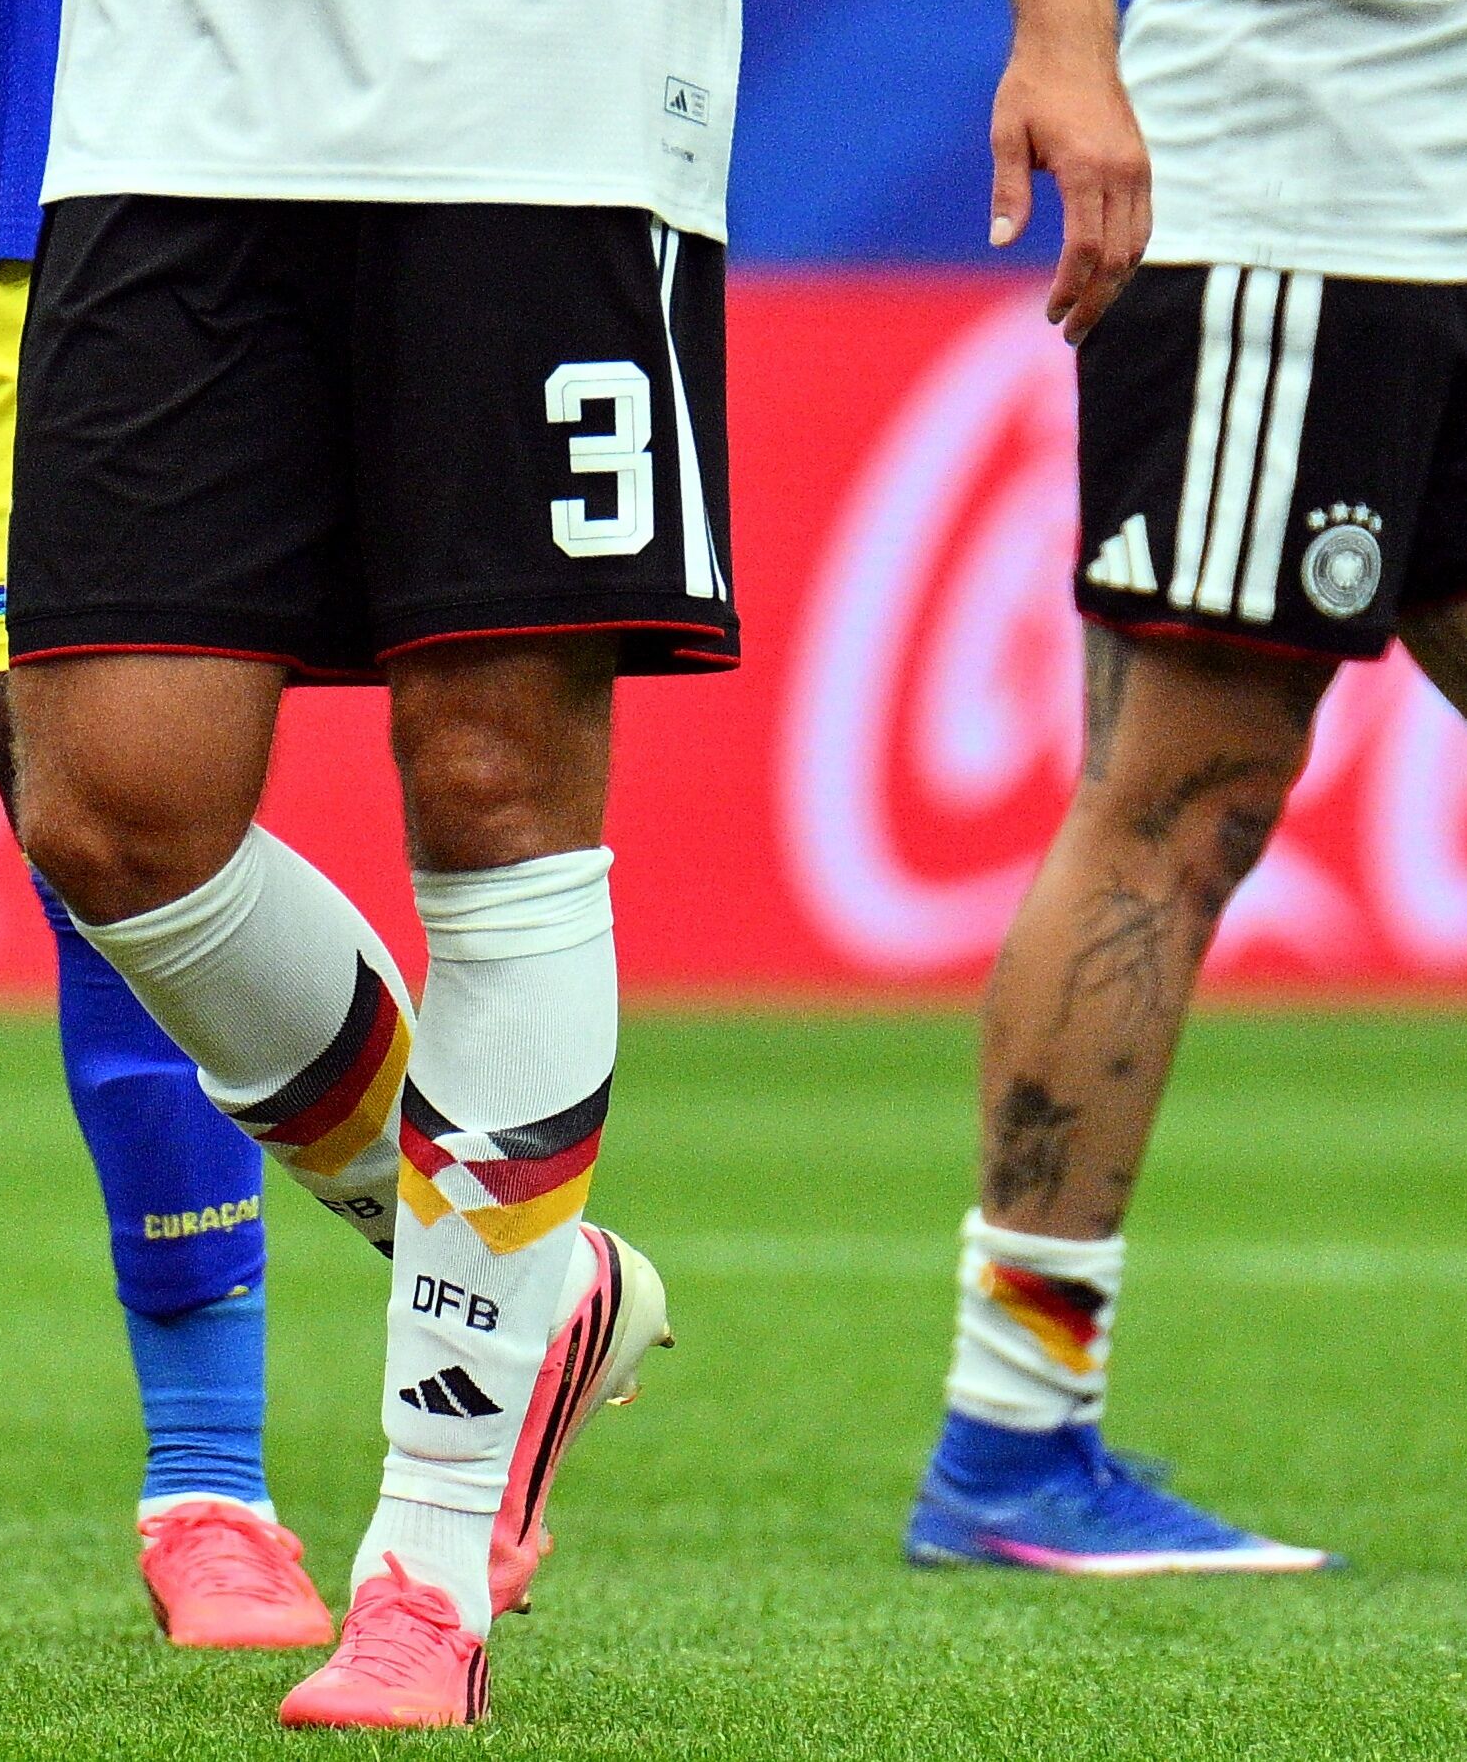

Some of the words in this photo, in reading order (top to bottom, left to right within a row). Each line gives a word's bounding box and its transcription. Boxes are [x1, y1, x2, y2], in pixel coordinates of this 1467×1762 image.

[544, 360, 655, 559] 3
[316, 1196, 385, 1219] FB
[412, 1274, 500, 1333] DFB
